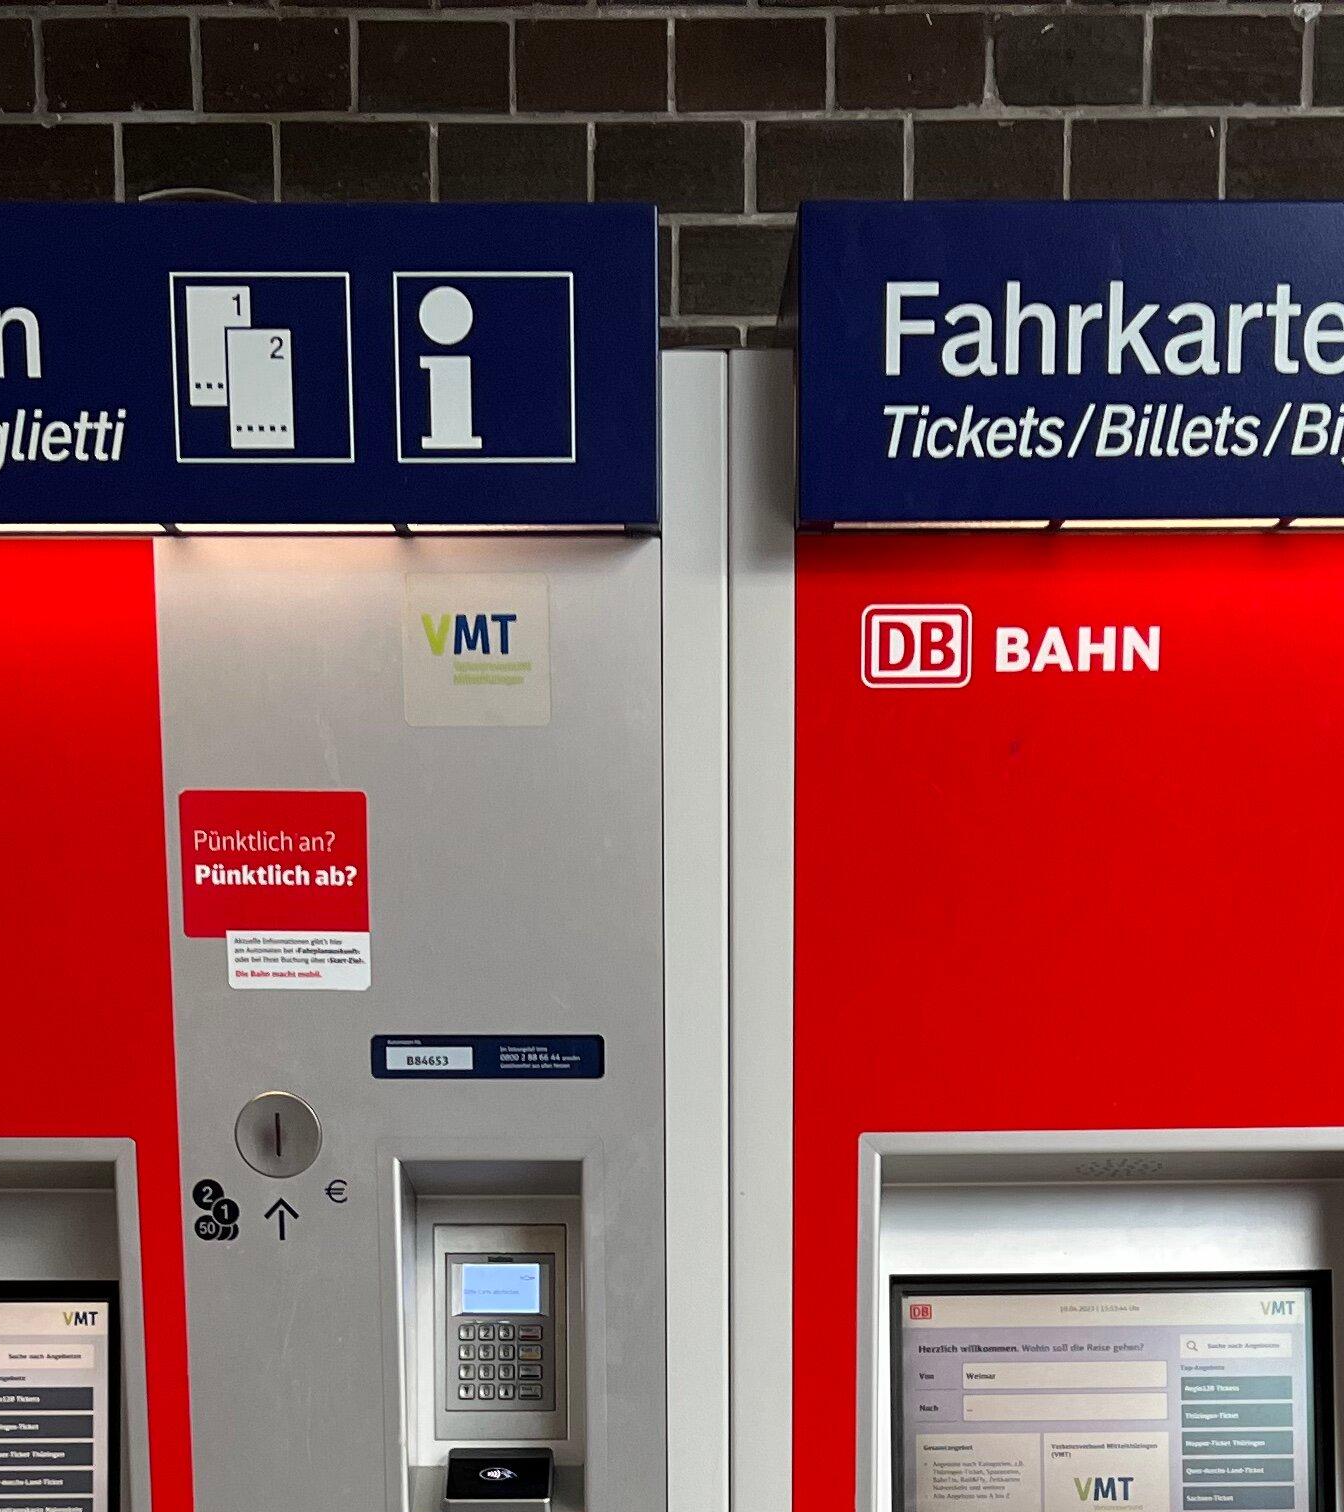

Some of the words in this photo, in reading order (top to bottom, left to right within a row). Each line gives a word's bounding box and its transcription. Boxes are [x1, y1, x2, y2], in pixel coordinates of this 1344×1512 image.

[231, 293, 242, 317] 1
[268, 337, 284, 361] 2
[420, 613, 518, 656] VMT
[876, 619, 957, 674] DB
[995, 625, 1161, 673] BAHN
[194, 830, 293, 852] Pünktlich
[298, 830, 336, 853] an?
[194, 863, 310, 887] Pünktlich
[314, 865, 358, 887] ab?
[406, 1055, 449, 1066] B84653
[202, 1186, 214, 1203] 2
[324, 1179, 348, 1204] €
[221, 1204, 229, 1220] 1
[199, 1221, 216, 1235] 50
[1260, 1300, 1295, 1315] VMT
[63, 1311, 98, 1326] VMT
[918, 1345, 958, 1353] Herzlich
[966, 1372, 996, 1380] Weimar
[1073, 1477, 1134, 1501] VMT
